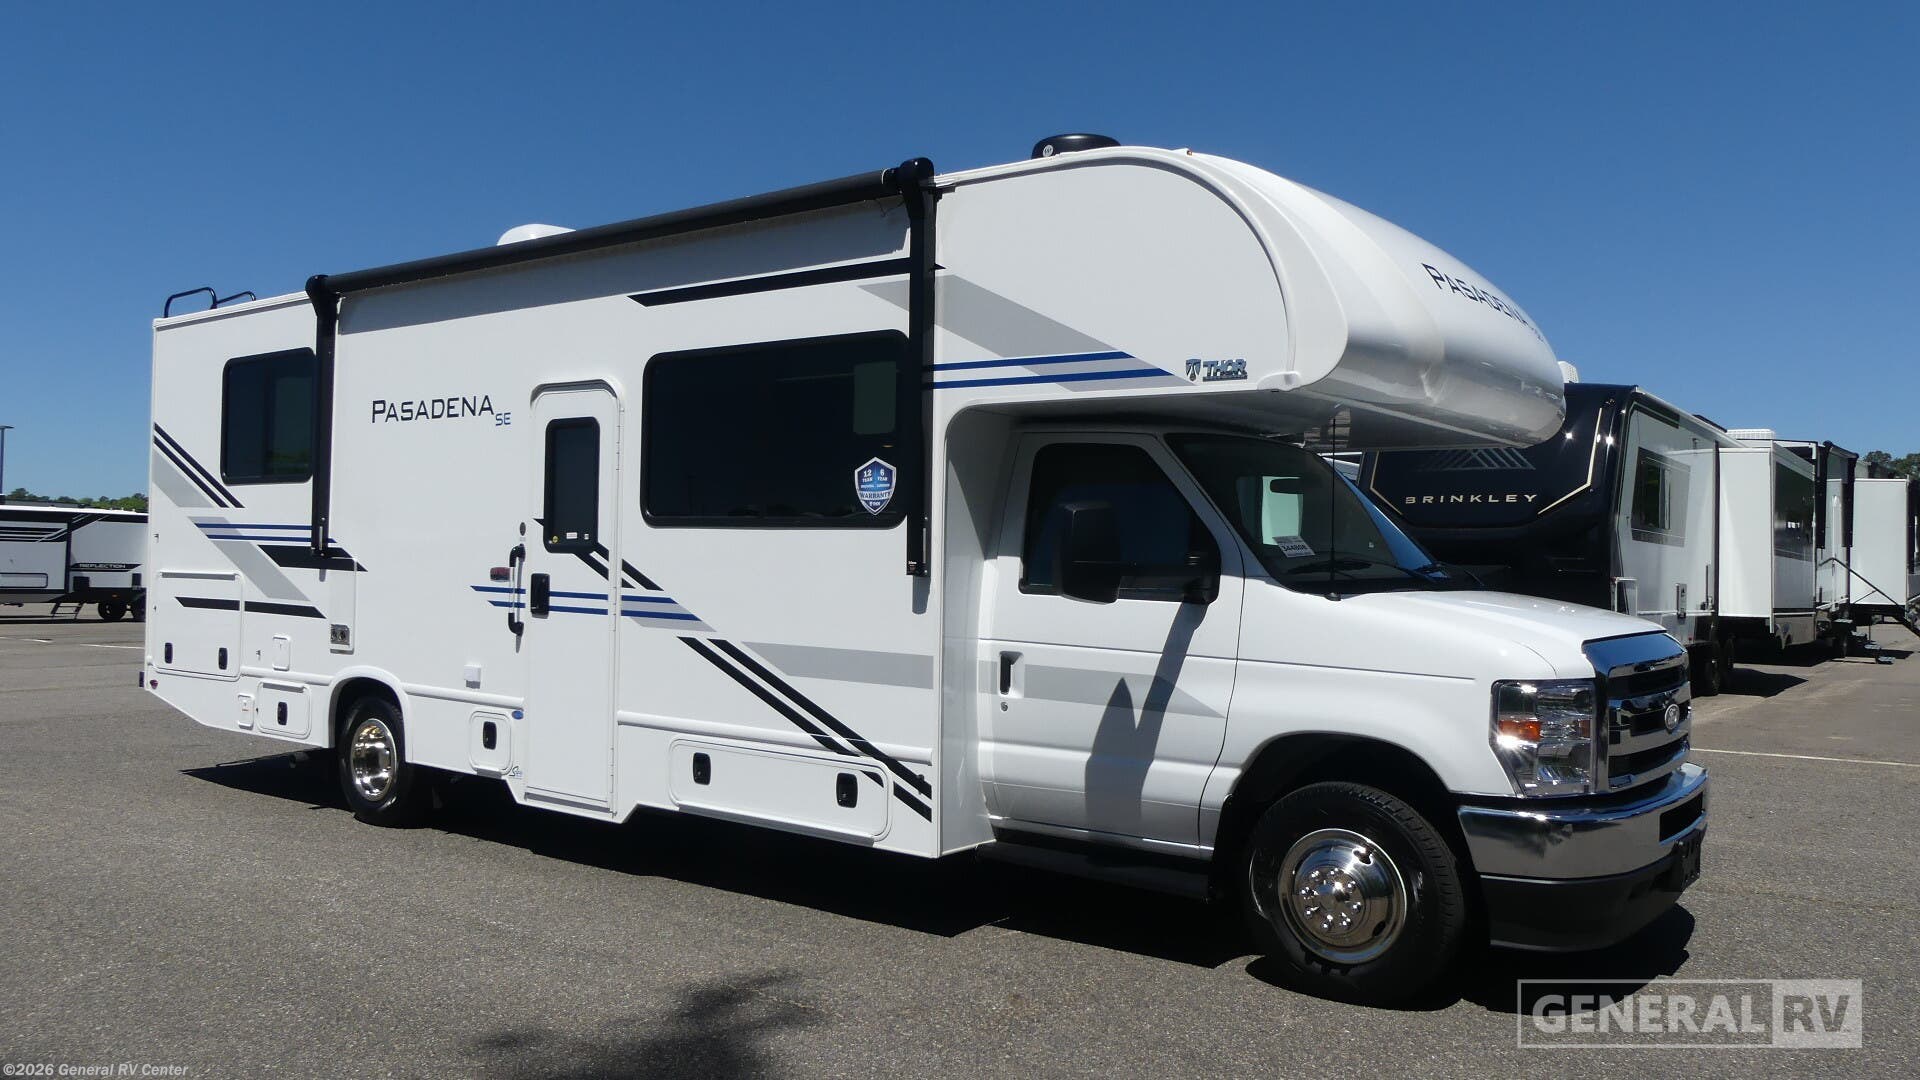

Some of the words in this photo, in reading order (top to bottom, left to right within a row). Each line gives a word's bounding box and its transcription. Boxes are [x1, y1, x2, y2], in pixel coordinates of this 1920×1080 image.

[1203, 360, 1247, 377] THOR
[371, 395, 494, 423] PASADENA
[495, 412, 511, 426] SE
[863, 469, 872, 477] 12
[1405, 494, 1537, 504] BRINKLEY
